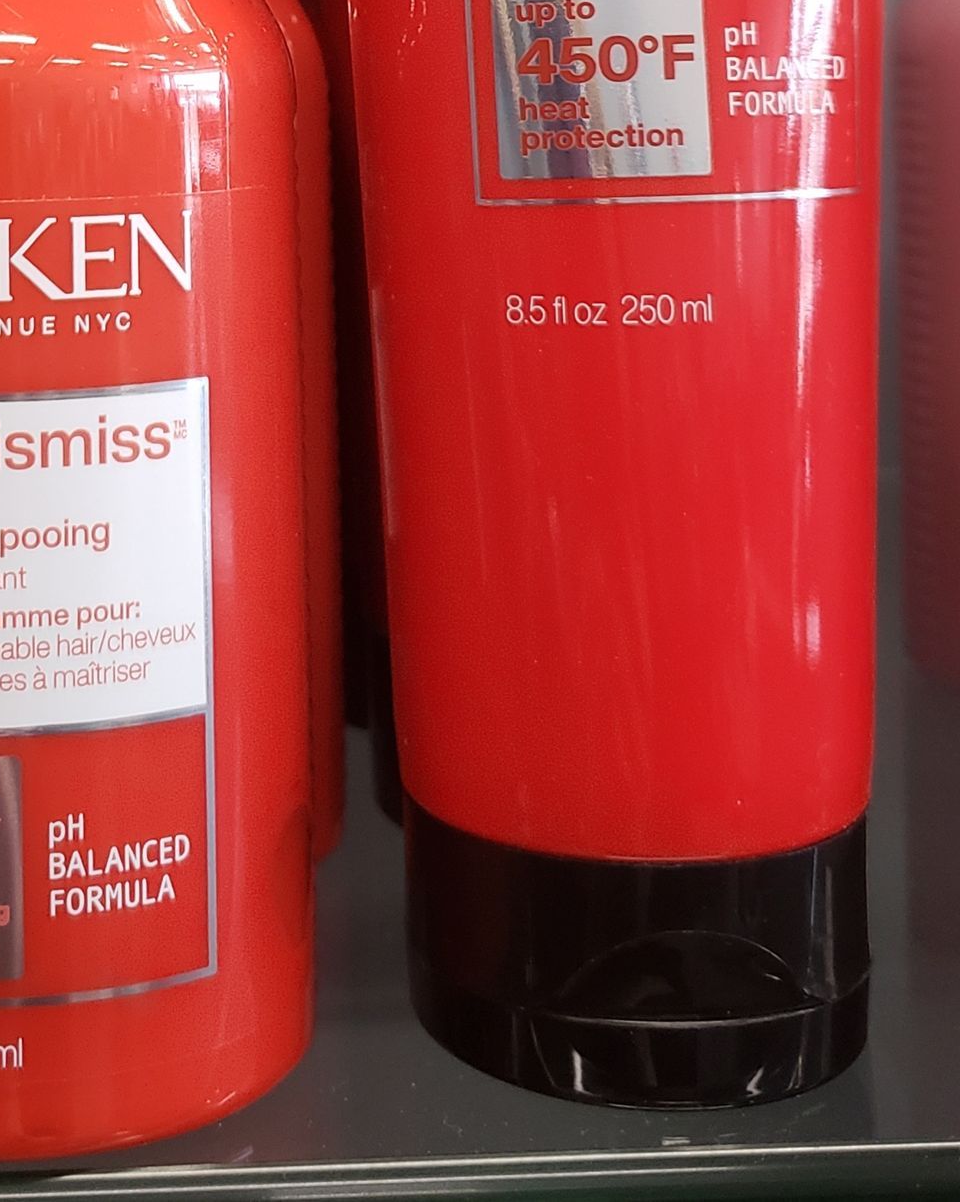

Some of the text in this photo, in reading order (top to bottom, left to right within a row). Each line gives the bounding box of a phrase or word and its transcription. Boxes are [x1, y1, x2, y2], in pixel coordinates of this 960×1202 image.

[515, 1, 556, 27] up
[724, 21, 757, 52] pH
[516, 33, 695, 86] 450°F
[518, 96, 590, 121] heat
[728, 89, 836, 117] FORMULA
[521, 123, 685, 156] protection
[74, 311, 133, 332] NYC
[506, 293, 713, 326] 8.5 fl oz 250 ml
[76, 599, 140, 630] pour:
[56, 623, 196, 657] hair/cheveux
[33, 664, 48, 689] à
[54, 658, 152, 690] maîtriser
[48, 814, 84, 849] pH
[48, 834, 190, 880] BALANCED
[49, 873, 176, 917] FORMULA
